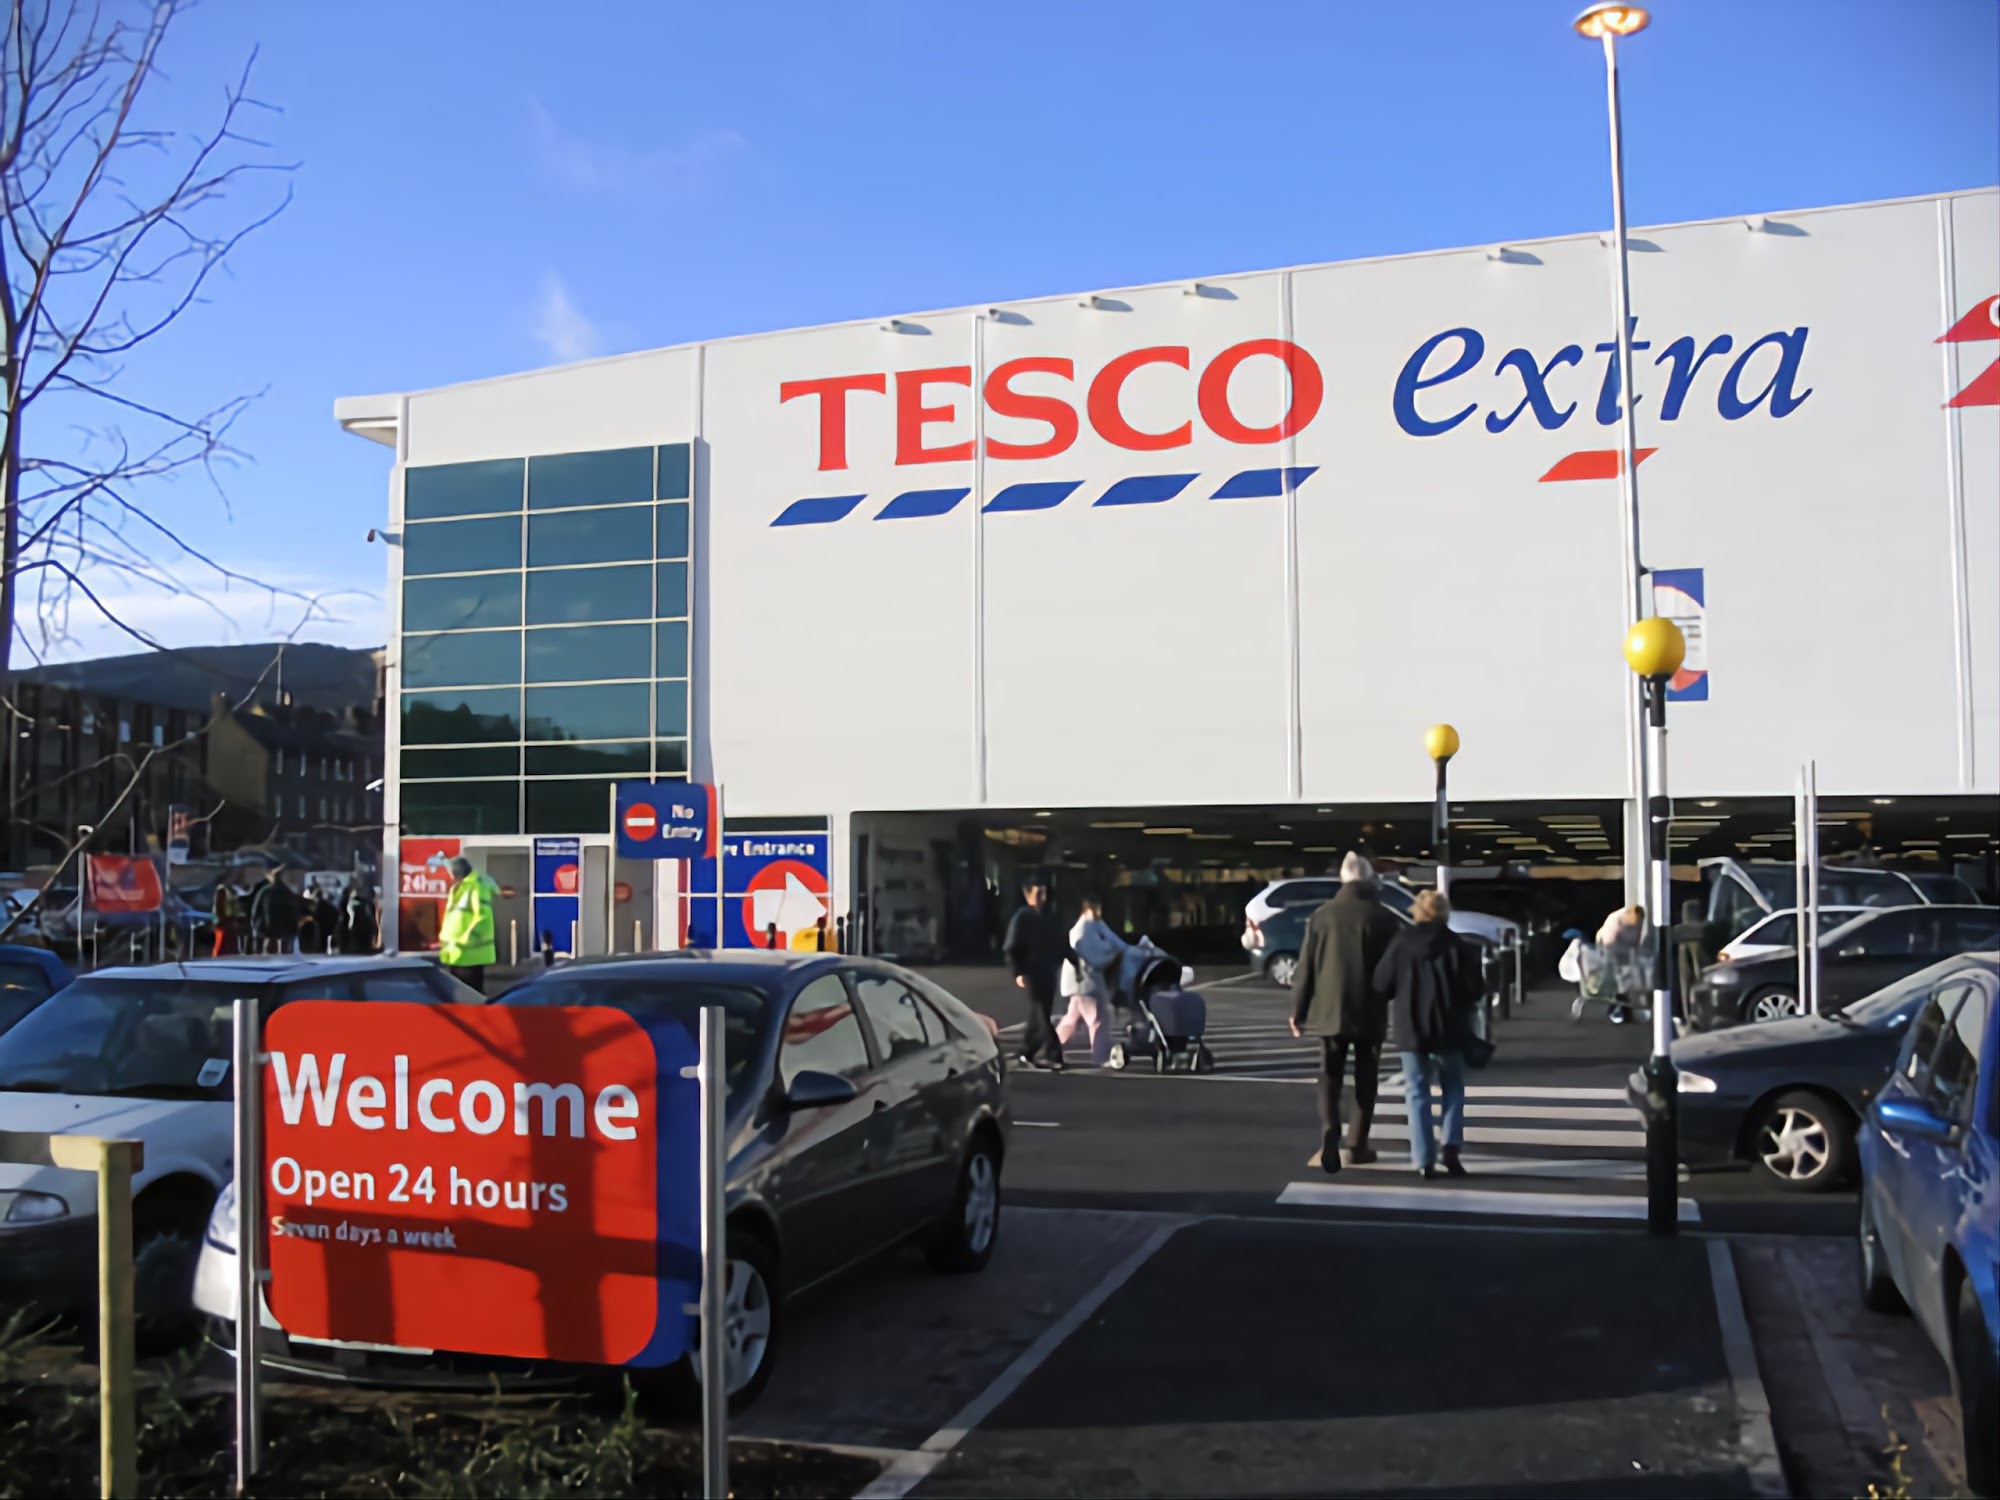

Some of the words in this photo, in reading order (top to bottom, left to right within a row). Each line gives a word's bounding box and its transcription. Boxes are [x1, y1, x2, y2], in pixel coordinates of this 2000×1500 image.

[780, 338, 1324, 471] TESCO
[1393, 317, 1813, 437] extra
[672, 804, 695, 819] No
[743, 840, 815, 857] Entrance
[270, 1051, 640, 1141] Welcome
[271, 1157, 375, 1206] Open
[388, 1163, 436, 1204] 24
[450, 1166, 569, 1213] hours
[271, 1215, 330, 1240] Seven
[335, 1220, 382, 1247] days
[387, 1228, 398, 1243] a
[403, 1226, 457, 1249] week
